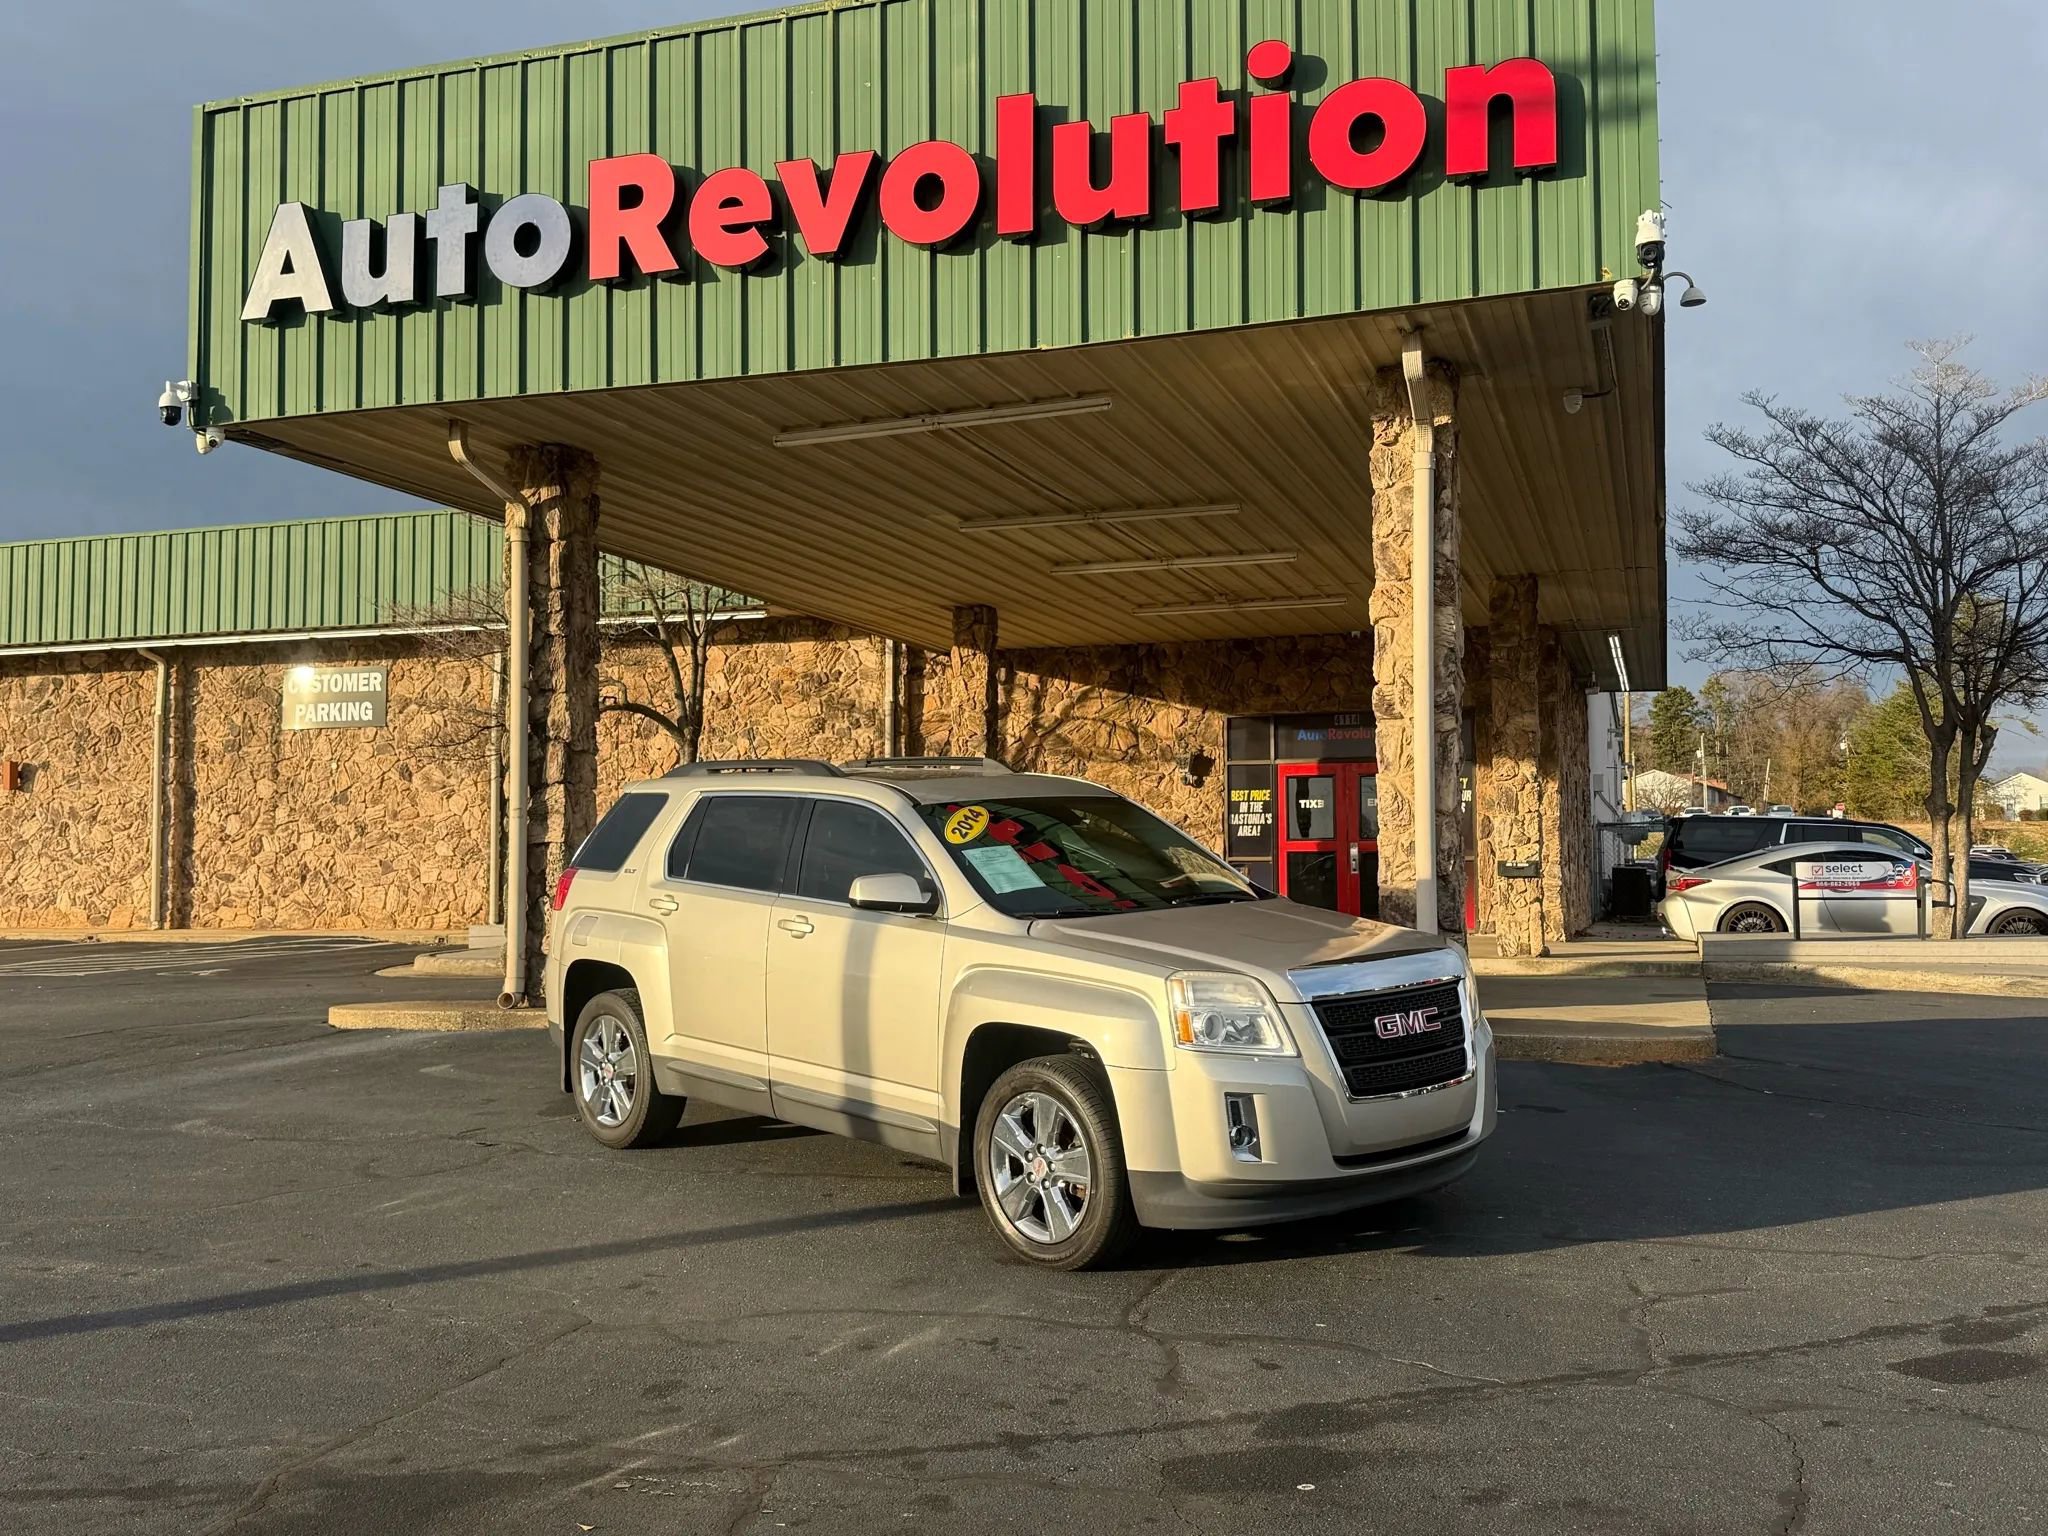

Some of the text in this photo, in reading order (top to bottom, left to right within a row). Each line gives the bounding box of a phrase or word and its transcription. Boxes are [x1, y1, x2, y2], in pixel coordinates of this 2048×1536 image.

[287, 672, 382, 694] CSTOMER
[295, 701, 373, 722] PARKING
[1231, 790, 1271, 801] BEST PRICE
[1239, 801, 1264, 813] IN THE
[951, 808, 984, 839] 2014
[1237, 825, 1261, 837] AREA!
[1825, 864, 1863, 872] select
[1375, 1007, 1441, 1039] GMC
